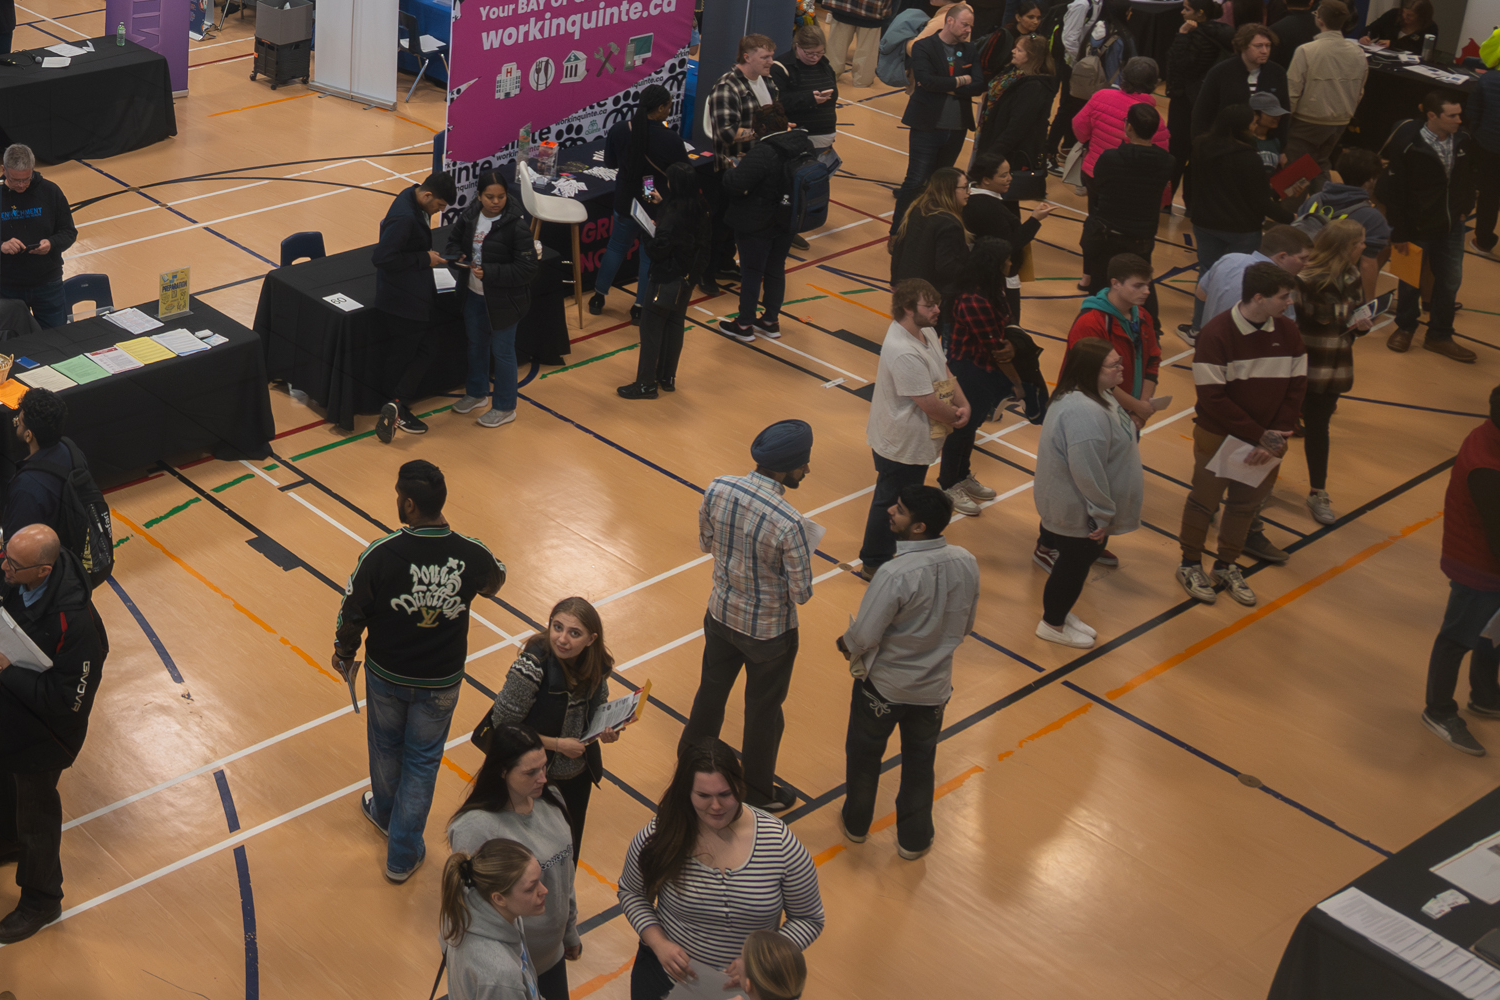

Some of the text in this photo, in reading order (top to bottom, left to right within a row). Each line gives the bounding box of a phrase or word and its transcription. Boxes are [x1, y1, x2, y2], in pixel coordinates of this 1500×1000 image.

[479, 4, 515, 20] Your
[629, 76, 664, 91] nquinte.ca
[451, 159, 492, 184] inte
